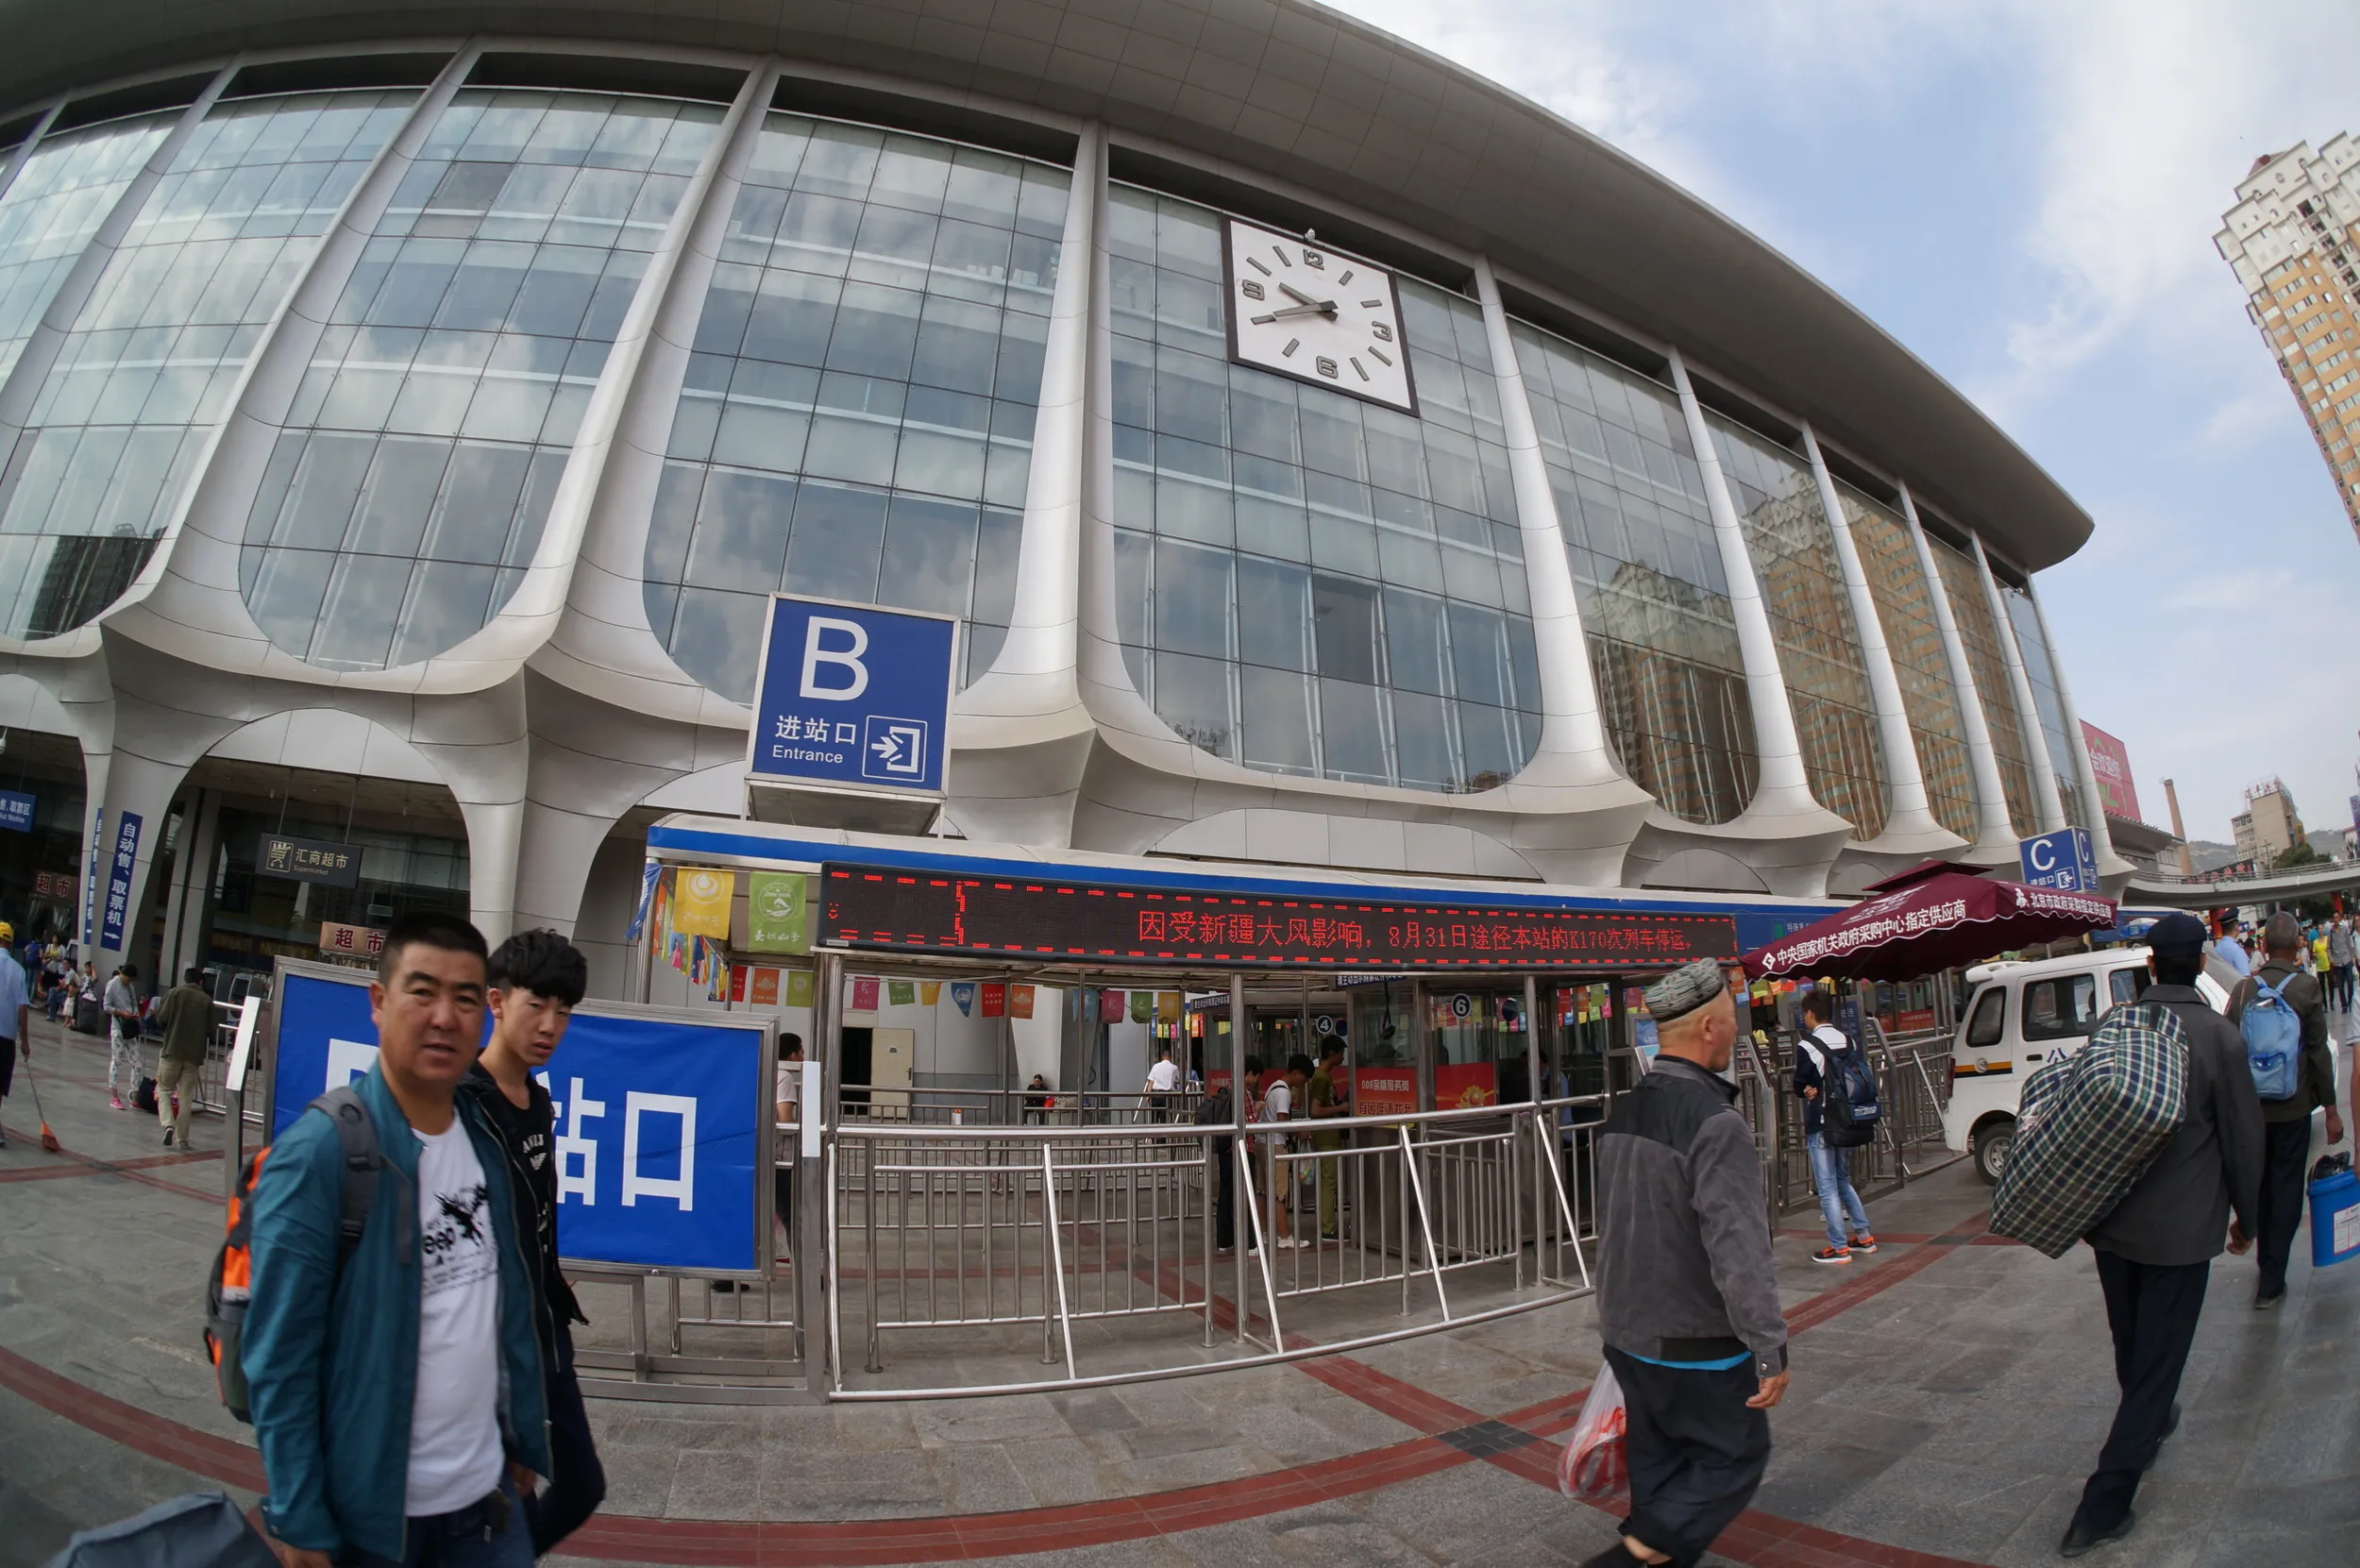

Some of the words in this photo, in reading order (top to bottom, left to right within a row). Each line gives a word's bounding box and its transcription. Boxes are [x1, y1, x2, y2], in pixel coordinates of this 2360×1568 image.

[1303, 248, 1324, 271] 12
[1242, 278, 1265, 301] 9
[1372, 321, 1393, 342] 3
[1316, 355, 1339, 379] 6
[800, 615, 868, 701] B
[775, 715, 857, 745] 进站口
[772, 745, 843, 764] Entrance
[295, 848, 349, 868] 汇商超市
[2031, 839, 2055, 870] C
[36, 872, 71, 898] 超市
[107, 822, 137, 926] 自动售、取票机
[334, 928, 385, 953] 超市
[1456, 998, 1467, 1017] 6
[1320, 1020, 1329, 1031] 4
